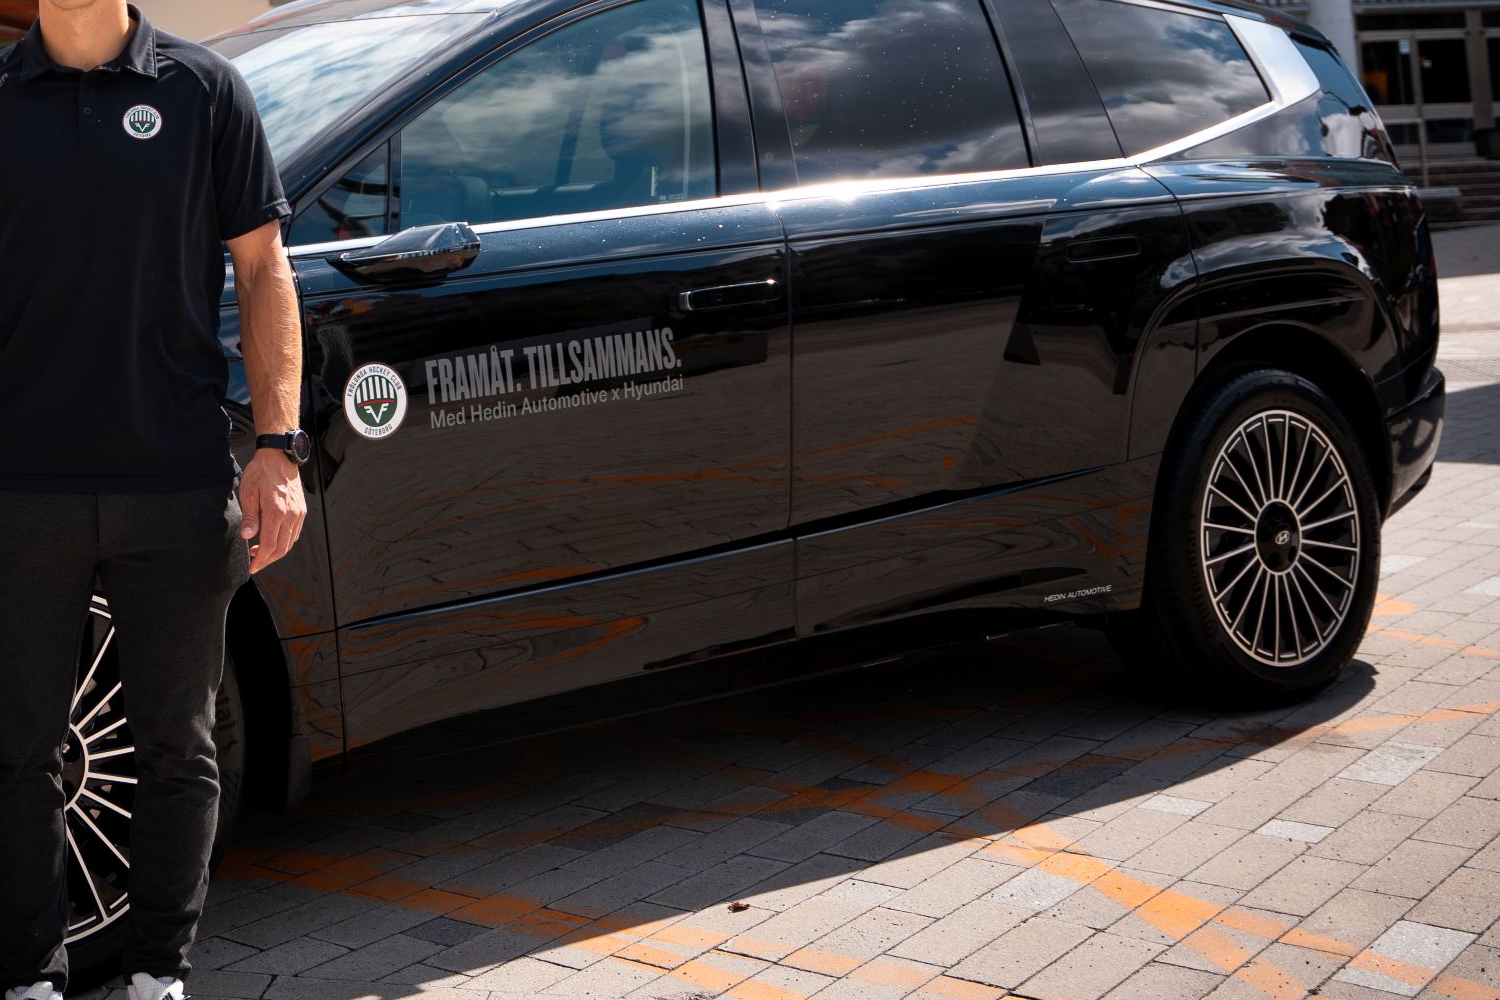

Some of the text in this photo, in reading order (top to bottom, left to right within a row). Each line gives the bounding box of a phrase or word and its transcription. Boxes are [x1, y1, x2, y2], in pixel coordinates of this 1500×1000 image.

[425, 327, 682, 405] FRAMÅT. TILLSAMMANS.
[430, 374, 684, 429] Med Hedin Automotive x Hyundai
[1044, 584, 1113, 602] HEDIN AUTOMOTIVE
